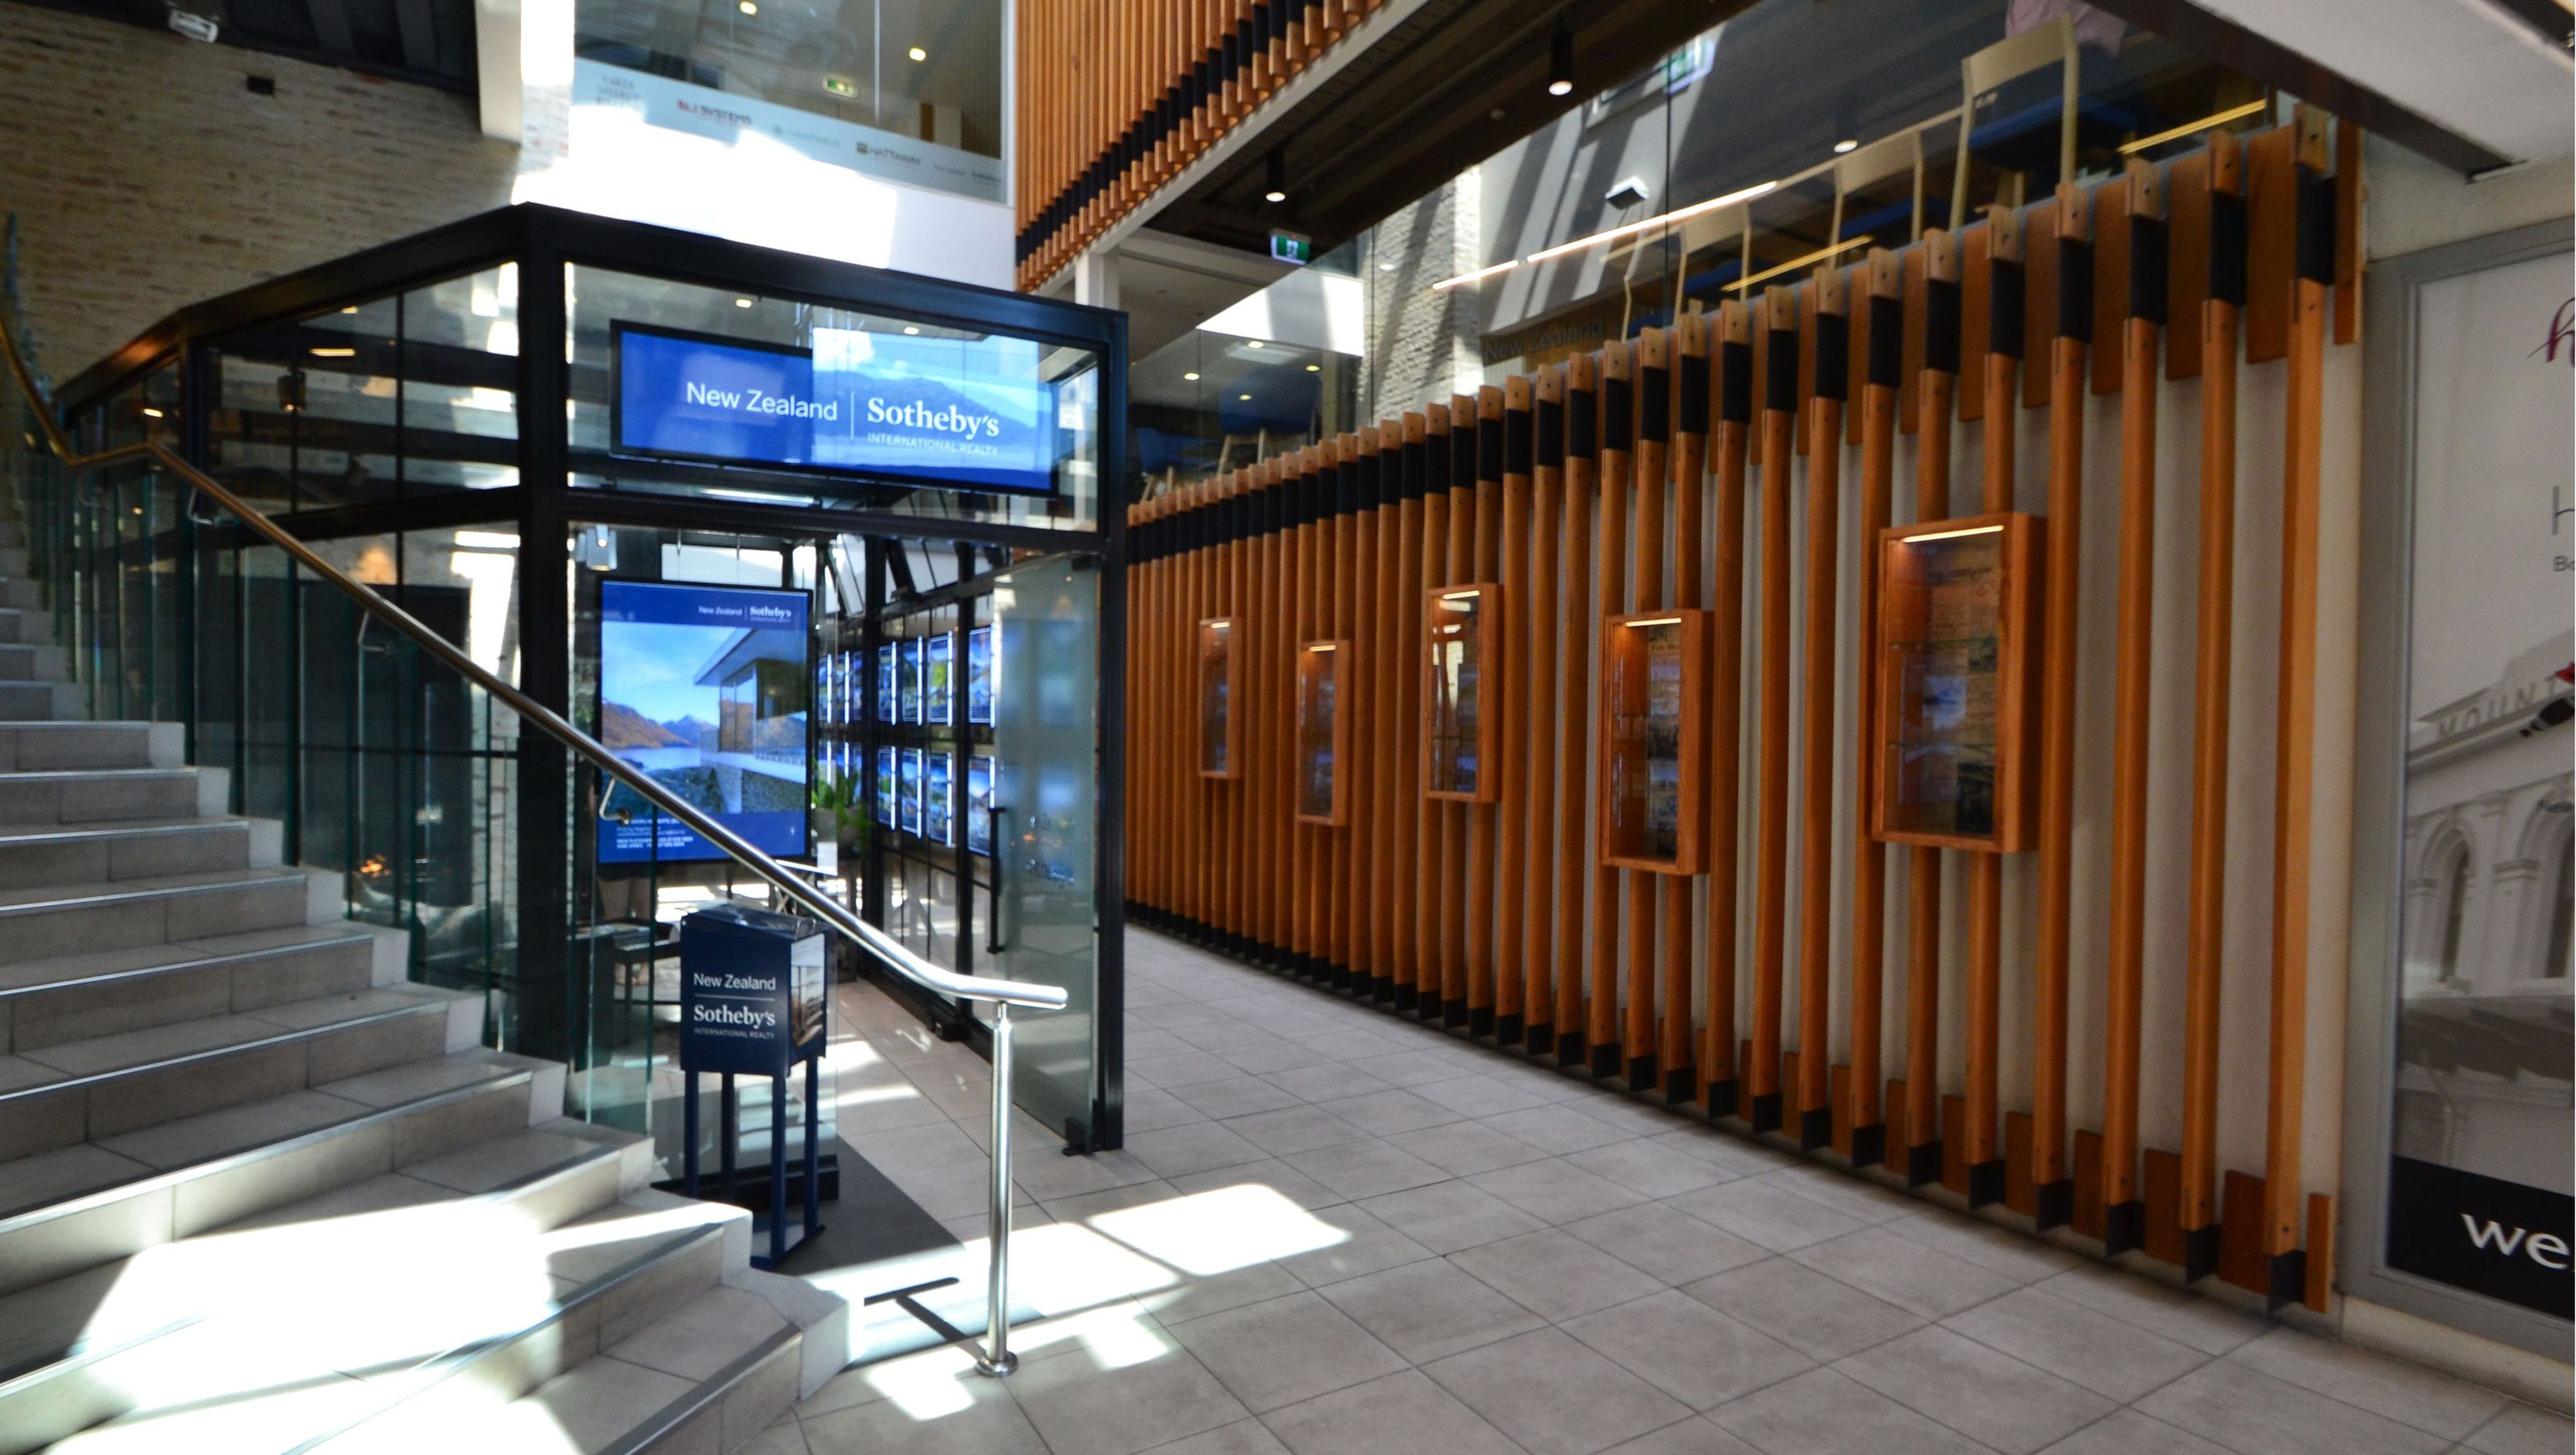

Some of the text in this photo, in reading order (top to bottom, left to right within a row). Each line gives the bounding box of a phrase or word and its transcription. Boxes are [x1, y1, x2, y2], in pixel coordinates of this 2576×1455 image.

[686, 381, 838, 422] New Zealand
[867, 396, 1001, 440] Sotheby's
[867, 432, 999, 457] INTERNATIONAL REALTY
[749, 606, 791, 618] Sotheby's
[693, 972, 776, 991] New Zealand
[693, 1003, 776, 1029] Sotheby's
[694, 1027, 775, 1040] INTERNATIONAL REALTY
